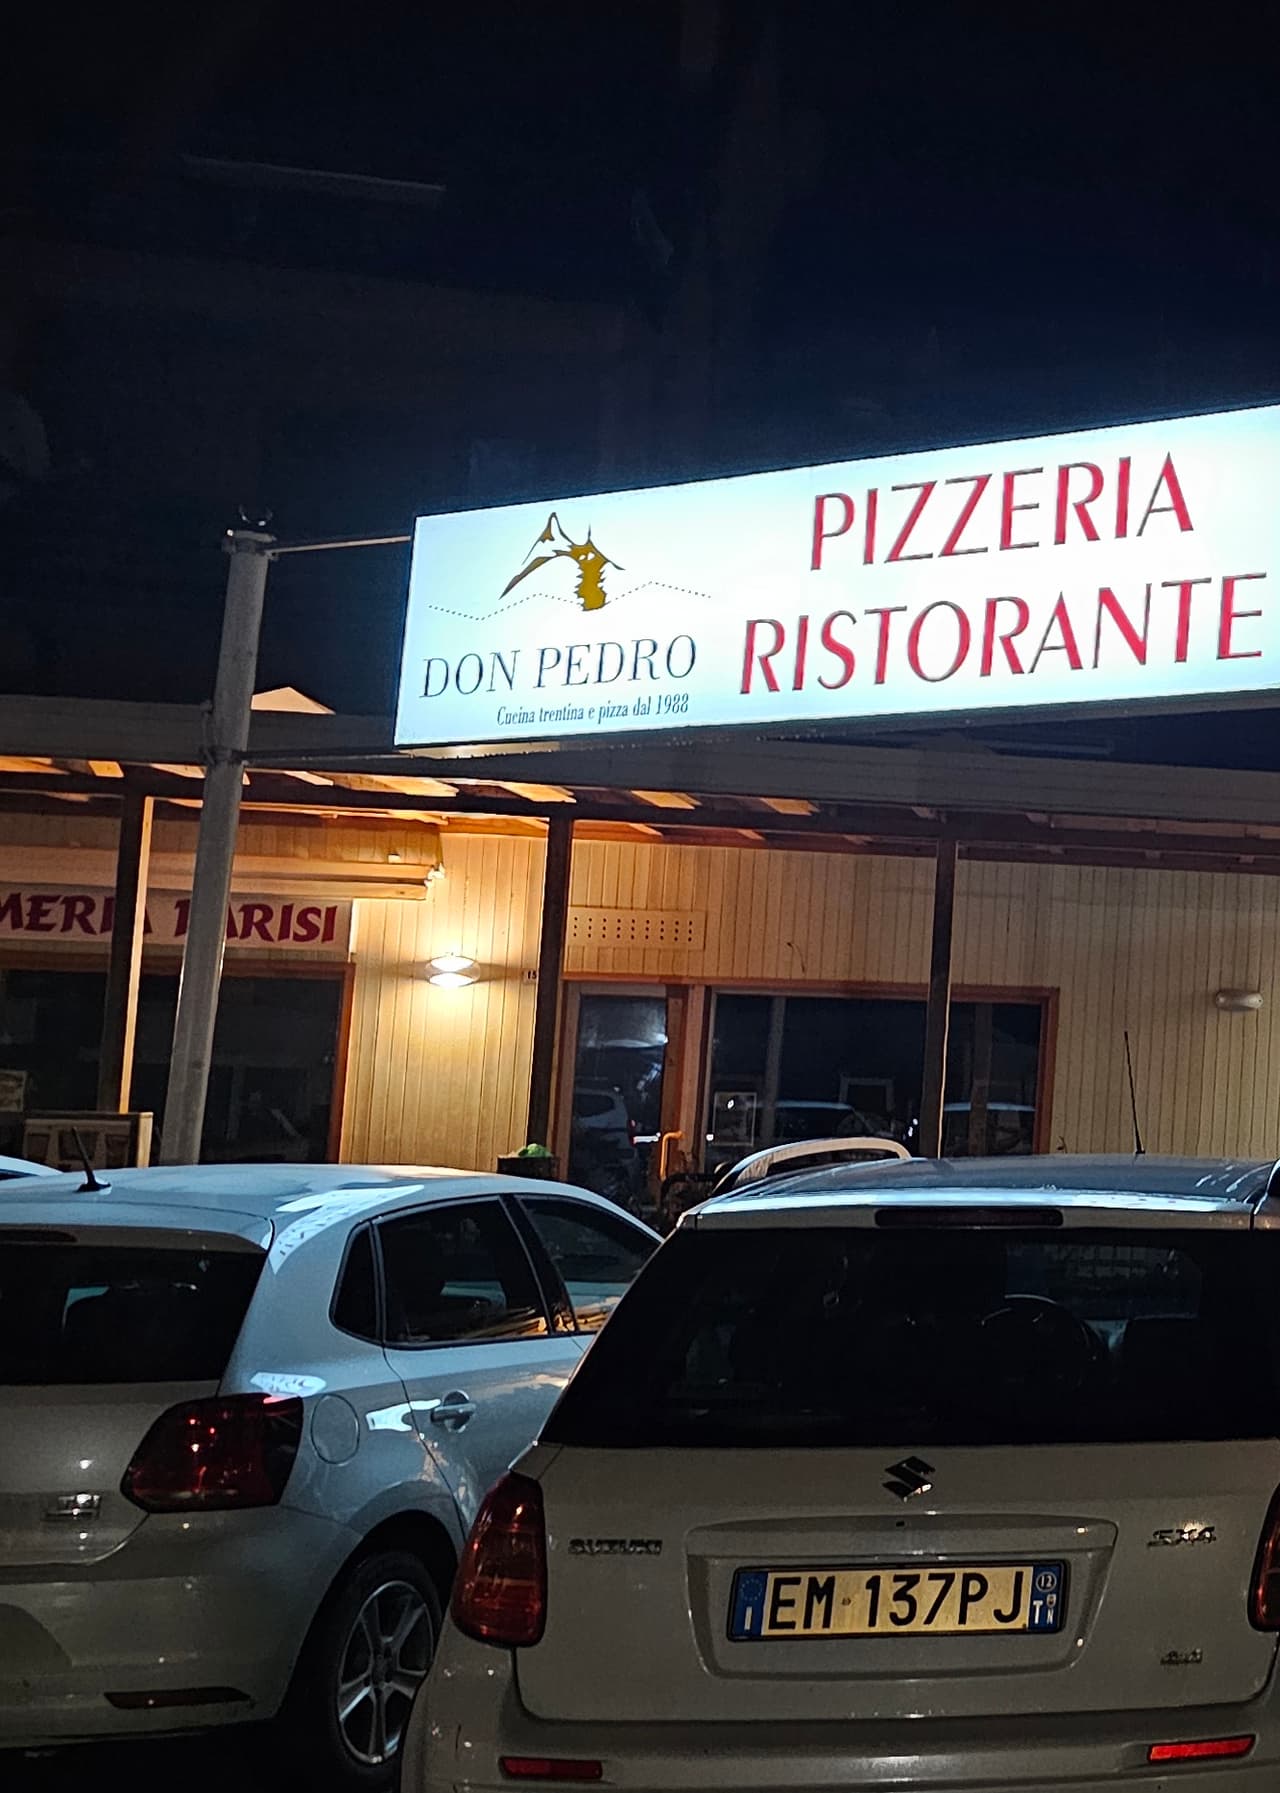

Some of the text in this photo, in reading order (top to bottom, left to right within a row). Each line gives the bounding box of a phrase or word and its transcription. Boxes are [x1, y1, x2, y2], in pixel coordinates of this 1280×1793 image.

[810, 452, 1194, 571] PIZZERIA
[739, 571, 1268, 696] RISTORANTE
[419, 635, 697, 698] DON PEDRO
[497, 693, 690, 727] Cucina trentina e pizza dal 1988
[0, 892, 153, 936] MERI
[768, 1570, 1025, 1630] EM 137PJ
[1040, 1575, 1053, 1588] 12
[743, 1606, 753, 1630] I
